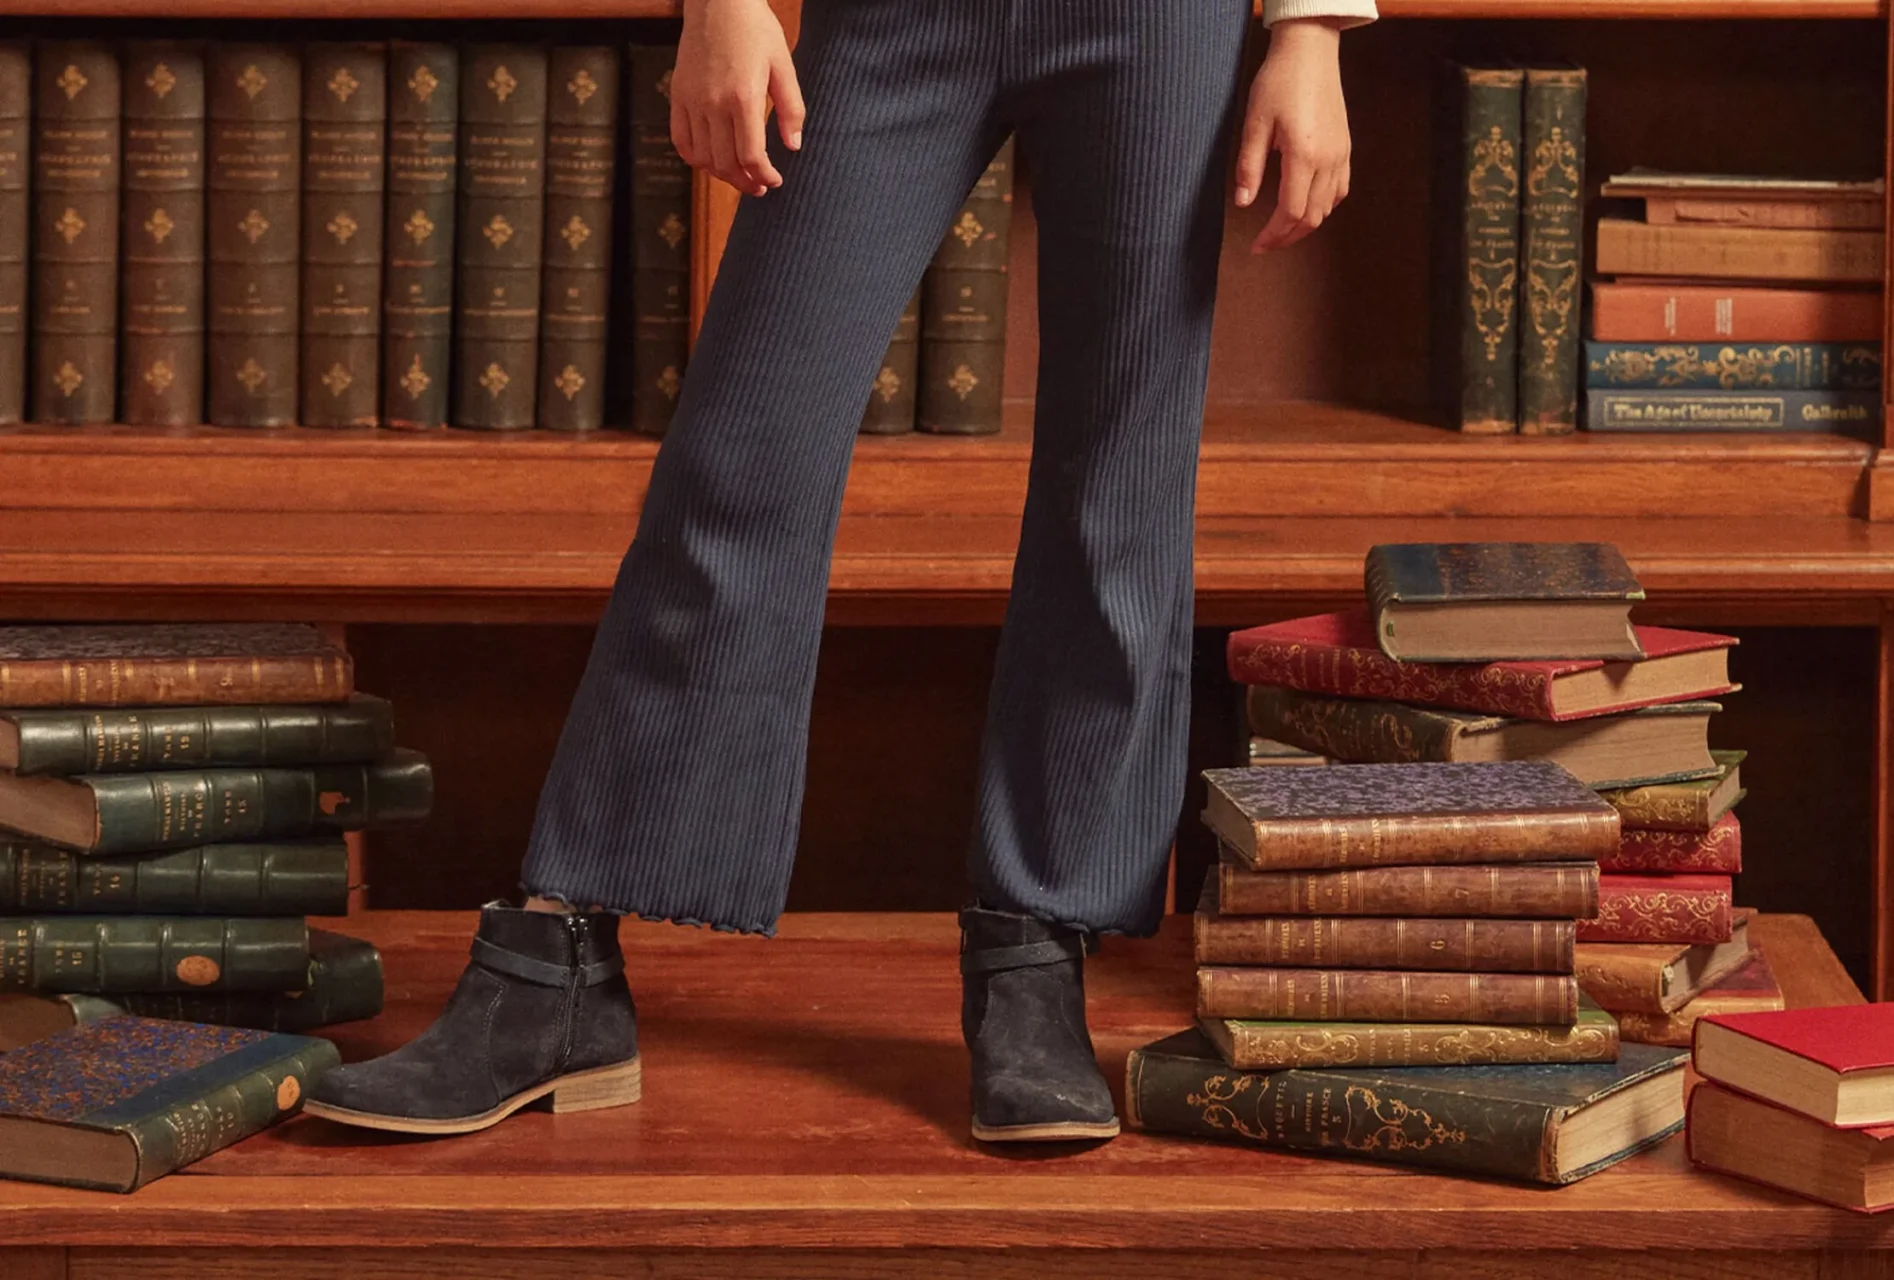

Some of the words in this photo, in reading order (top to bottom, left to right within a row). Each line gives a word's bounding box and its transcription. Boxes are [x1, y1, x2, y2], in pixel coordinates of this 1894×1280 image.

[1614, 404, 1642, 419] The
[1690, 404, 1773, 421] Uncertainty
[1802, 404, 1868, 420] Galbraith
[1431, 940, 1445, 950] 6
[17, 929, 28, 984] FRANCE
[1321, 1087, 1331, 1126] FRANCE
